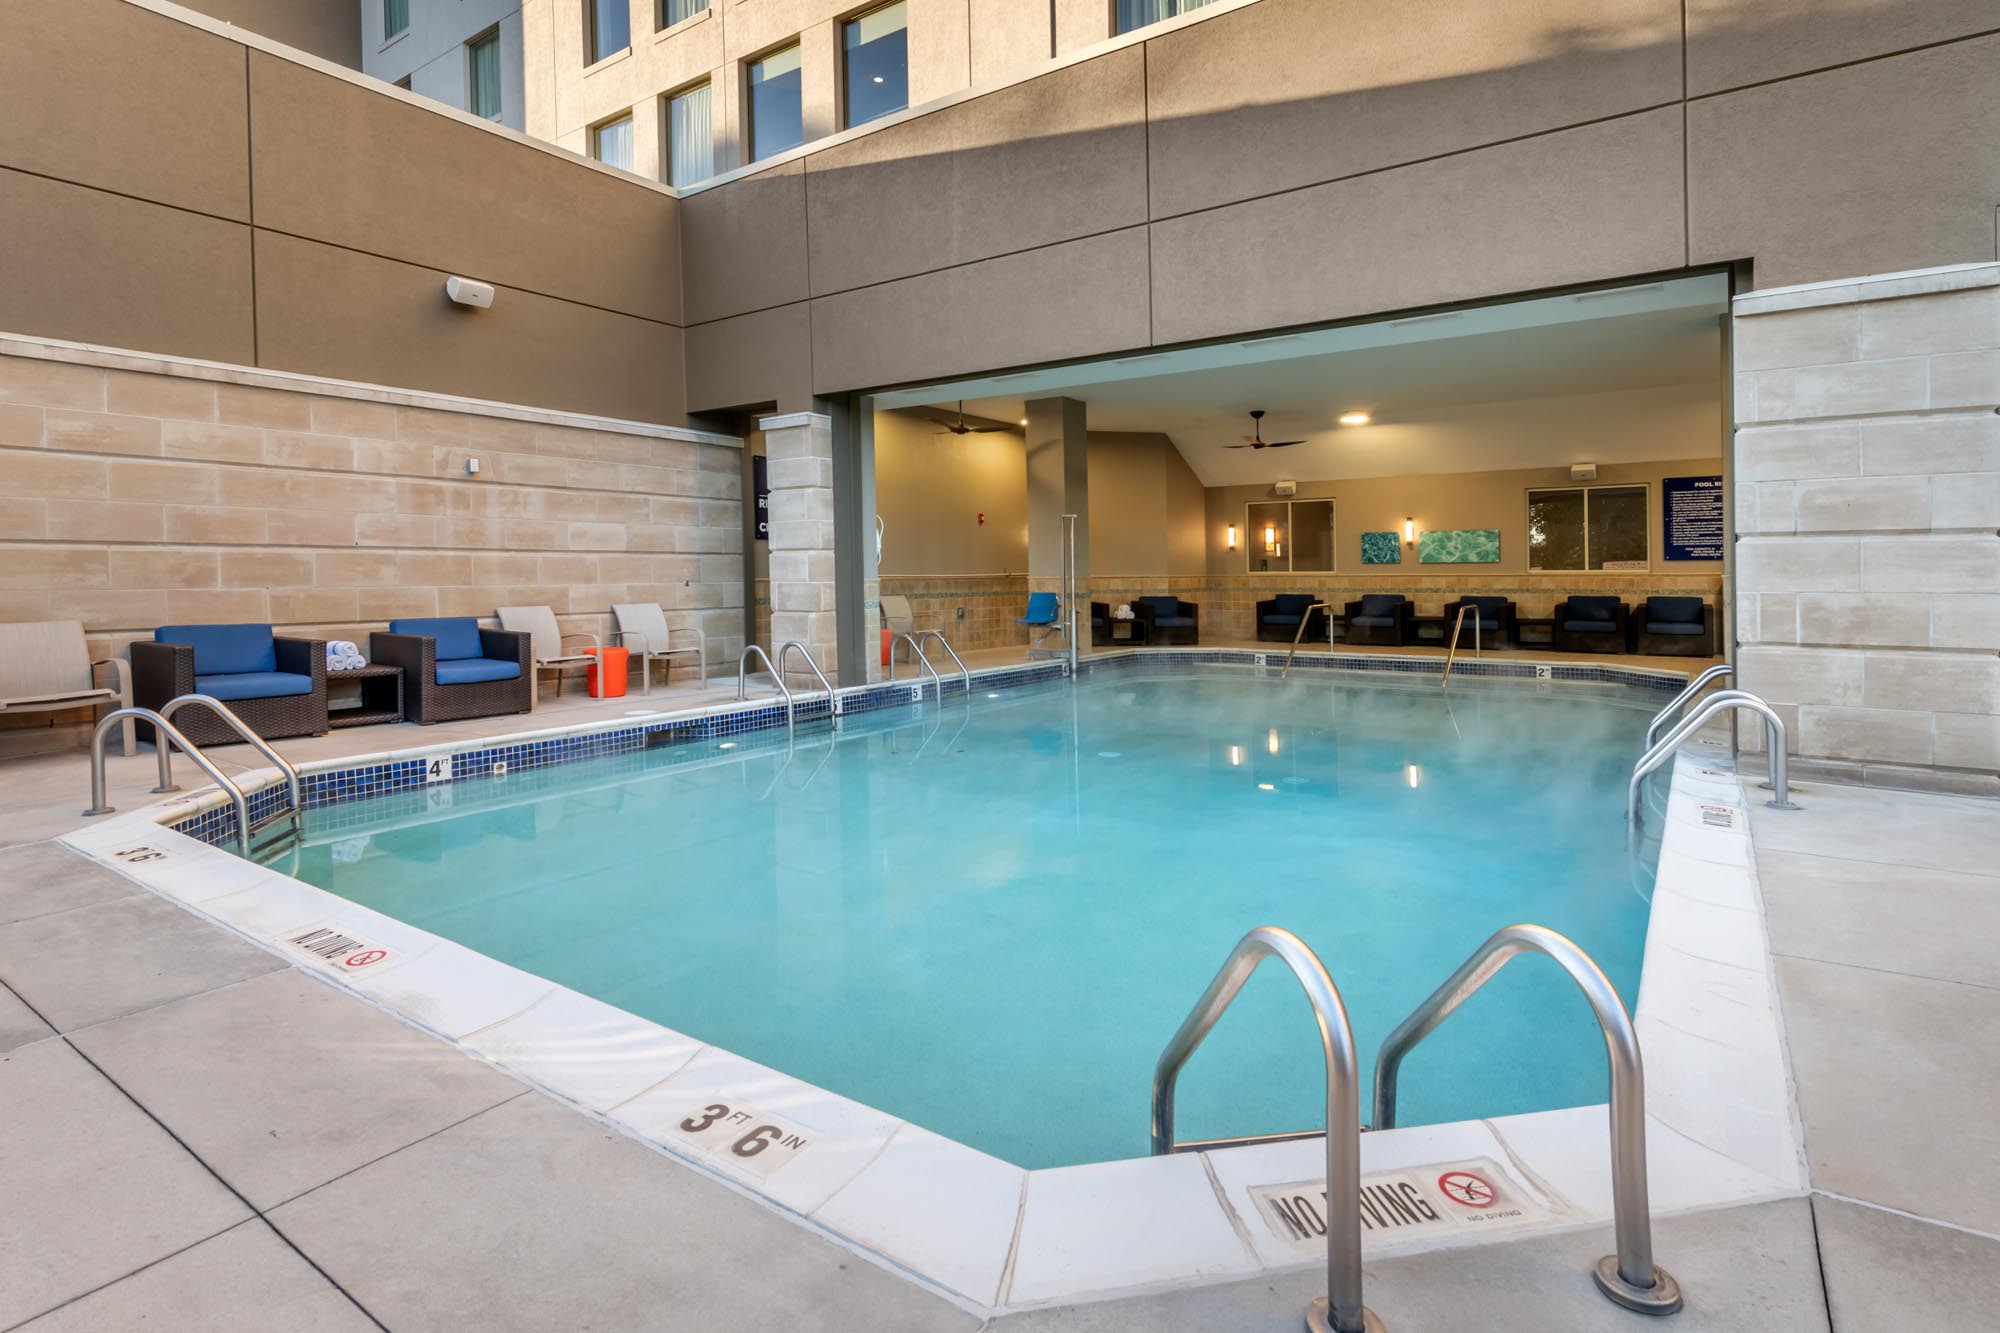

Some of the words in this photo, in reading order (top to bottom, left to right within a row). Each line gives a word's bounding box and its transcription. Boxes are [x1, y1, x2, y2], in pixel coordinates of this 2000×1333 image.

[429, 760, 441, 777] 4
[441, 758, 449, 766] FT
[128, 853, 162, 862] 6
[680, 1104, 730, 1132] 3
[726, 1111, 753, 1126] FT
[731, 1124, 783, 1157] 6
[780, 1134, 807, 1151] IN
[1270, 1196, 1328, 1240] NO
[1485, 1209, 1523, 1220] DIVING
